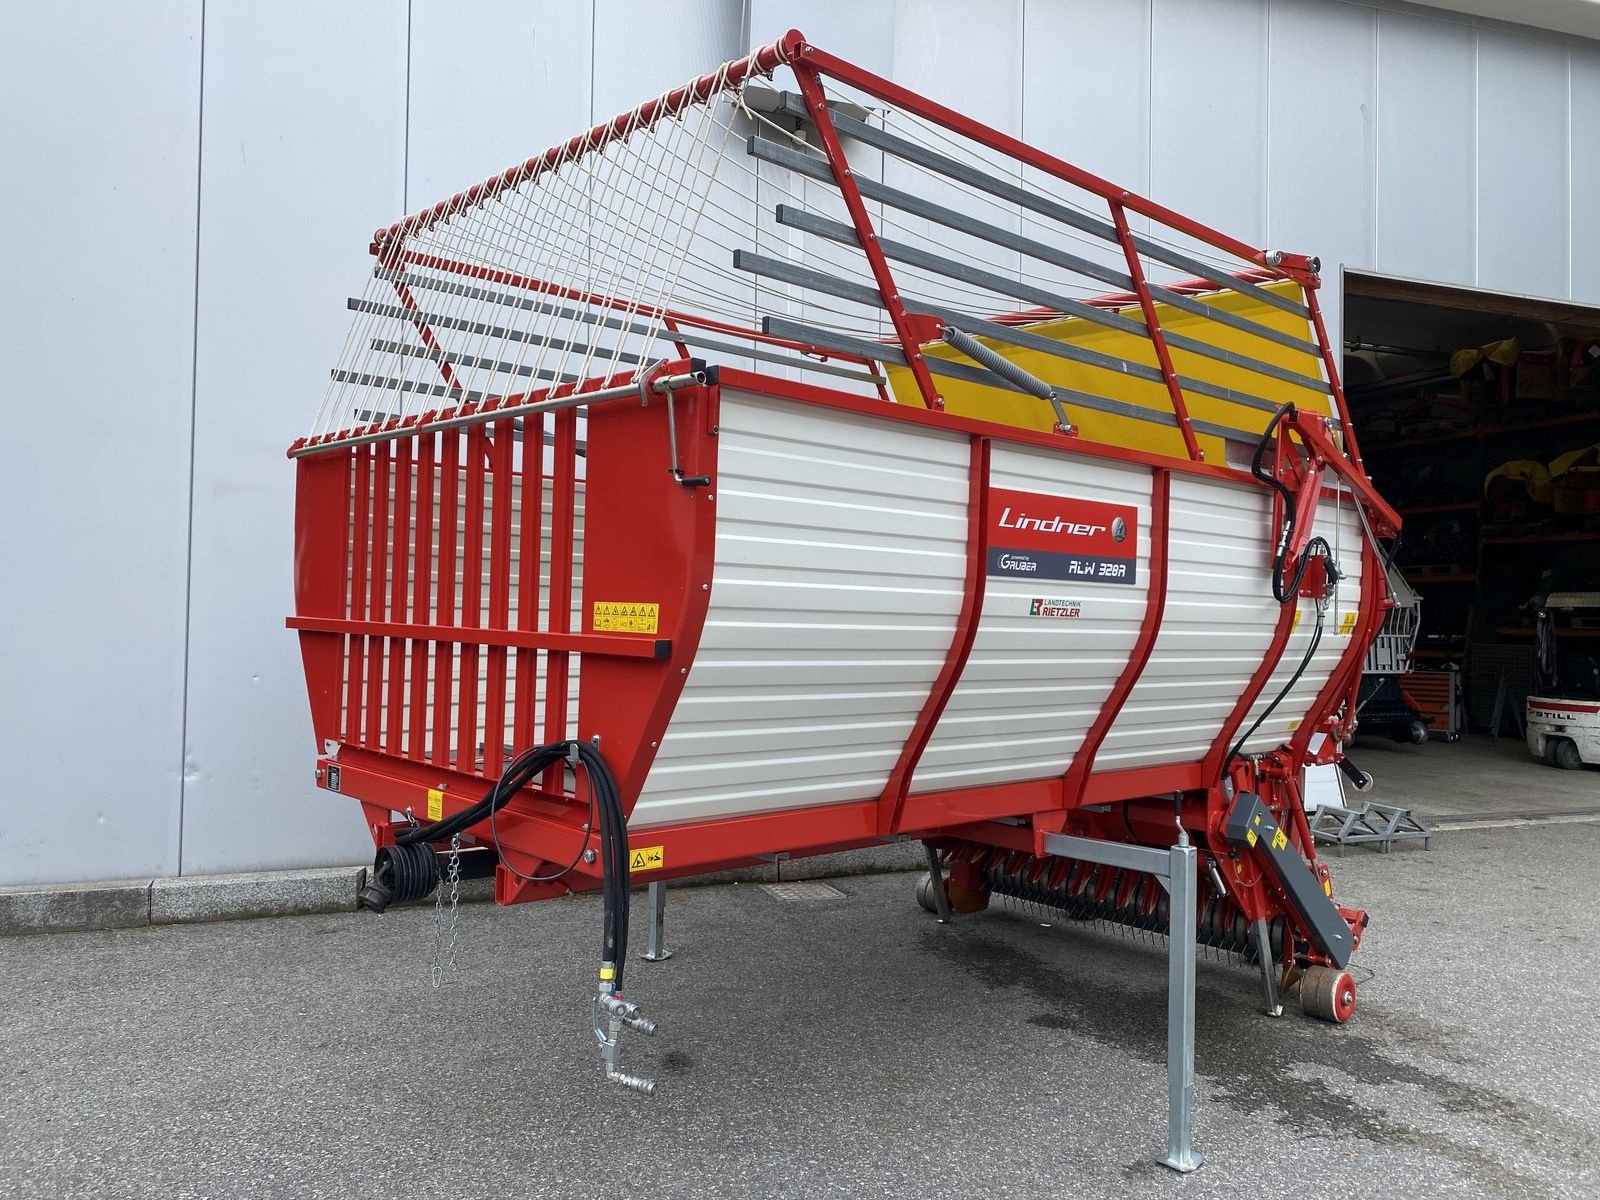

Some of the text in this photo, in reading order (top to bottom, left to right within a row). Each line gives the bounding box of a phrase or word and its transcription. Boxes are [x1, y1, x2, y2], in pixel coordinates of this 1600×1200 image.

[999, 507, 1106, 537] Lindner
[1098, 562, 1126, 577] 328R
[1044, 600, 1081, 608] LANDTECHNIK
[1042, 607, 1081, 617] RIETZLER
[1535, 711, 1576, 720] STILL
